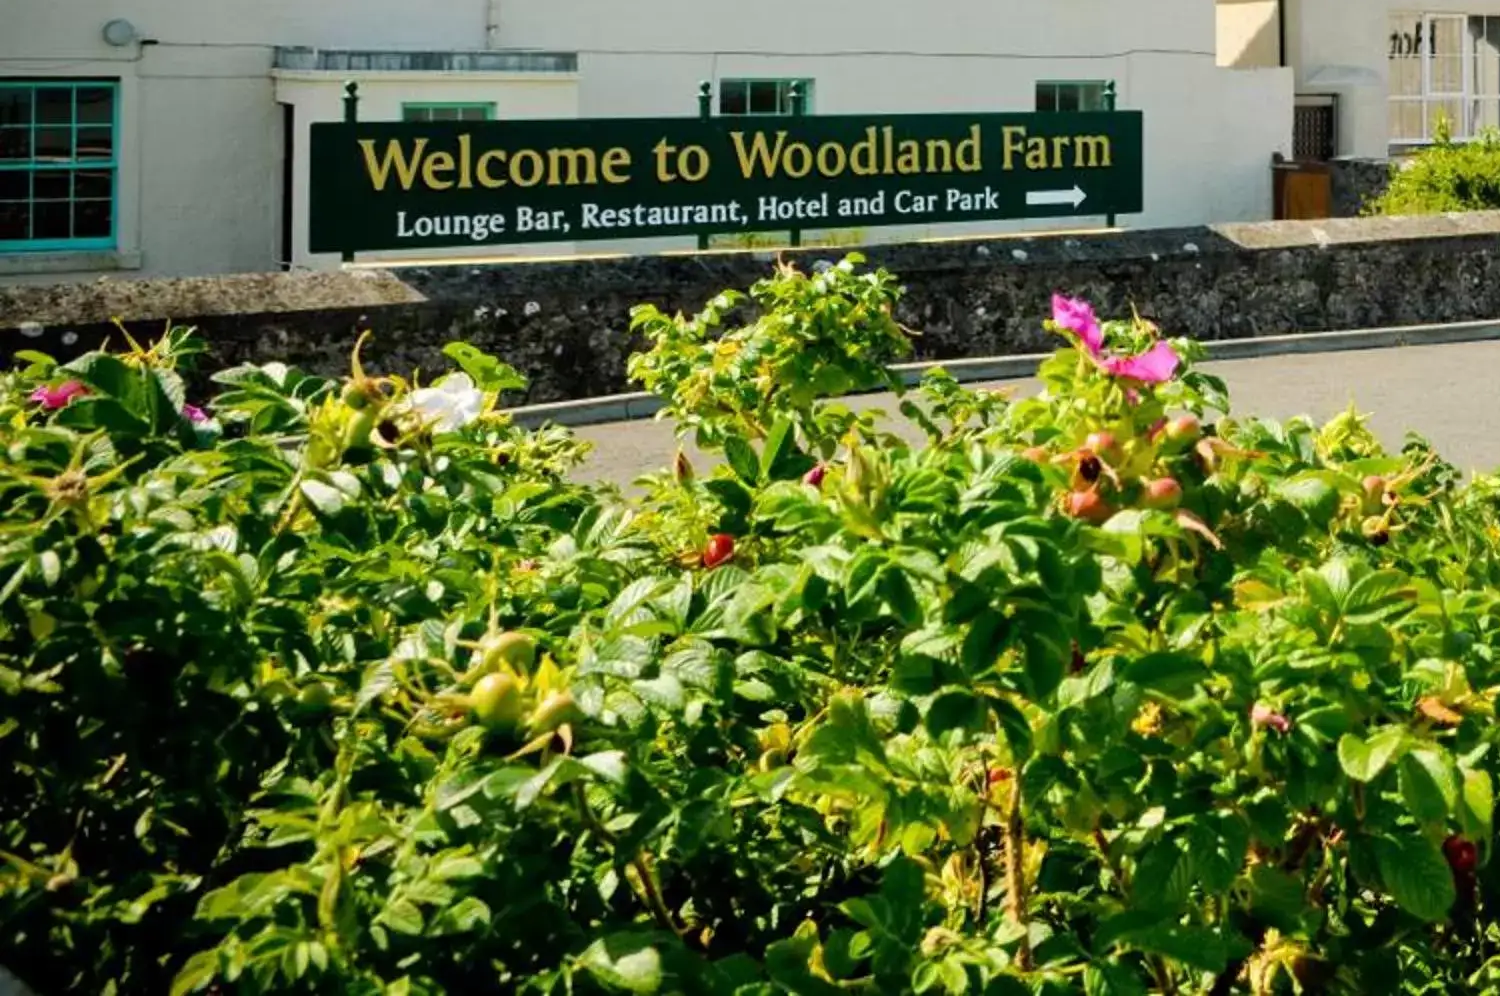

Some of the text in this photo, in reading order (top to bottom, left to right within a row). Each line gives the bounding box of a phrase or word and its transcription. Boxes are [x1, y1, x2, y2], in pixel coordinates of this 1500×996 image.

[357, 125, 1112, 192] Welcome to Woodland Farm
[396, 185, 1000, 241] Lounge Bar, Restaurant, Hotel and Car Park
